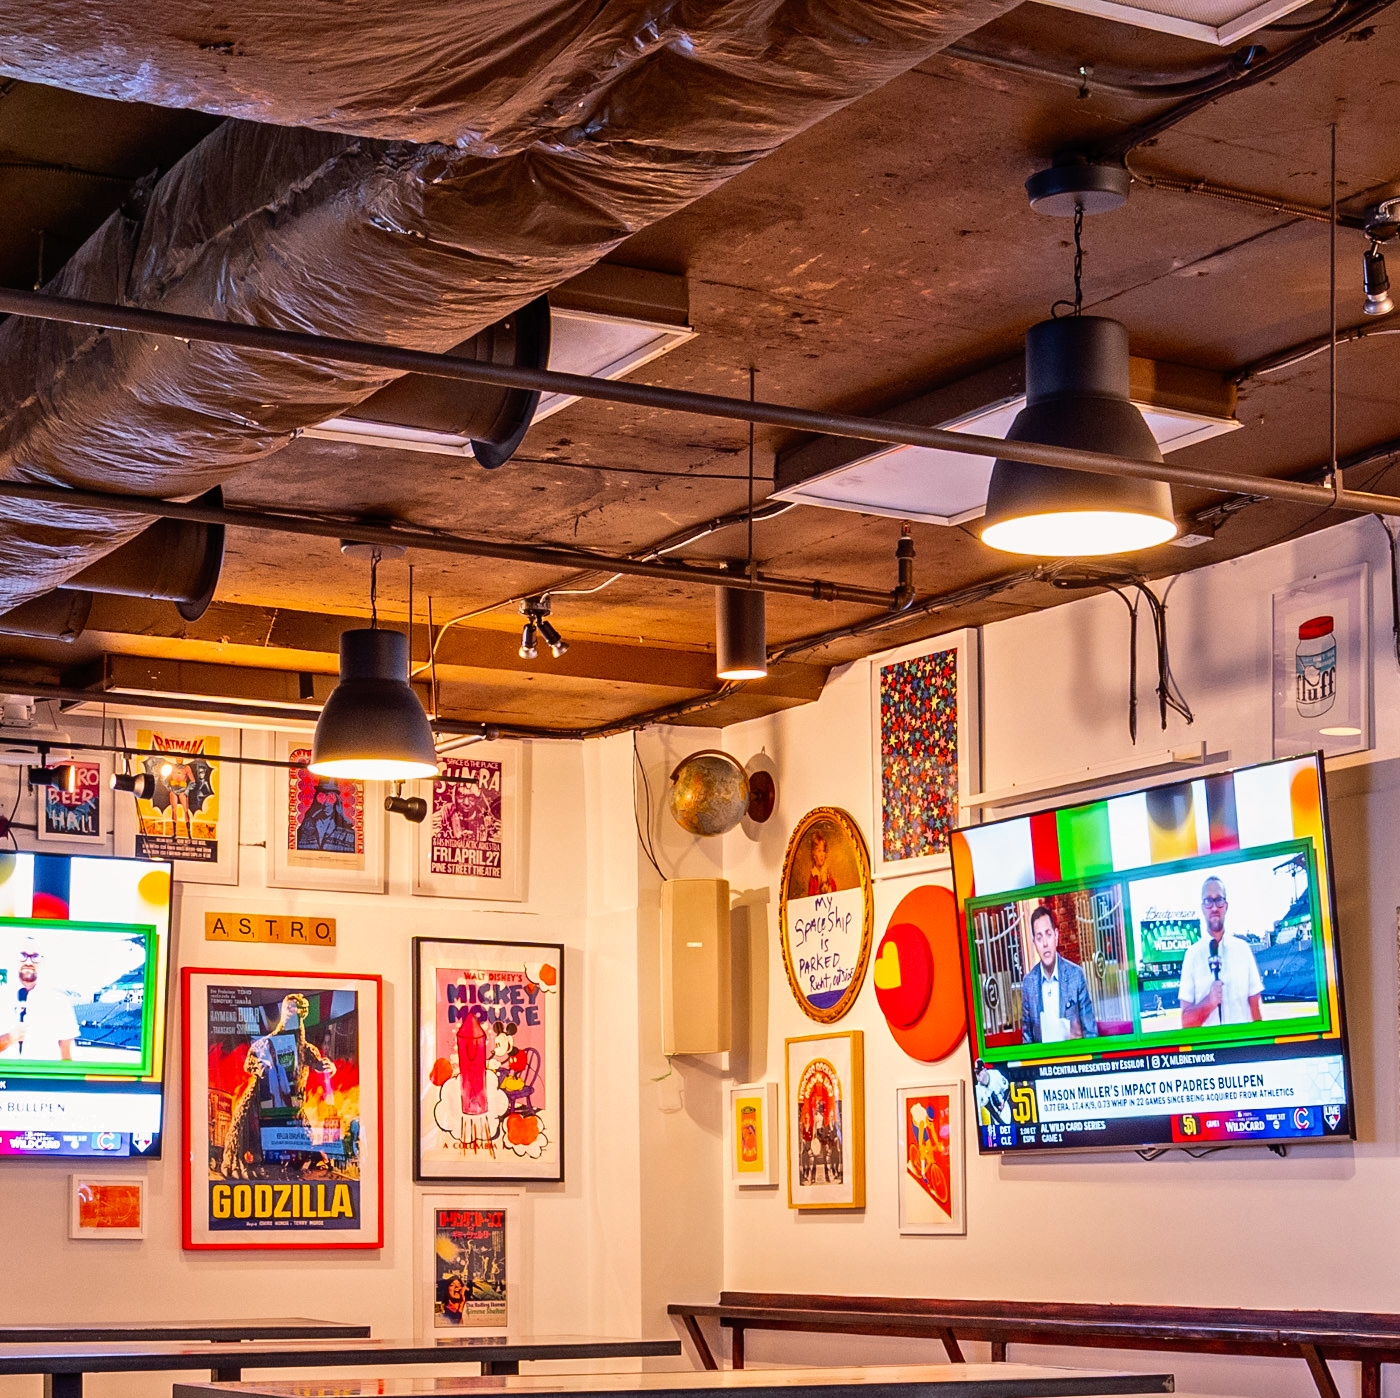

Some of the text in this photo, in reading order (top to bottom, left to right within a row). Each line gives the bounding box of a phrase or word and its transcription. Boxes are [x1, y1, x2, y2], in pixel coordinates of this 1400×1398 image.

[153, 734, 204, 755] BATMAN
[446, 758, 464, 767] SPACE
[470, 760, 480, 768] THE
[480, 761, 499, 769] PLACE
[479, 769, 500, 792] RA
[47, 788, 96, 809] BEER
[52, 809, 97, 834] HALL
[455, 848, 484, 865] APRIL
[485, 852, 500, 866] 27
[431, 863, 500, 877] PINE STREET THEATRE
[799, 952, 841, 978] PARKED
[464, 972, 523, 983] WALT DISNEY'S
[447, 983, 540, 1005] MICKEY
[448, 1005, 541, 1027] MOUSE
[1040, 1067, 1052, 1076] MLB
[1052, 1065, 1078, 1076] CENTRAL
[1078, 1062, 1111, 1074] PRESENTED
[1043, 1074, 1264, 1101] MASON MILLER'S IMPACT ON PADRES BULLPEN
[1111, 1099, 1129, 1107] WHIP
[1167, 1096, 1185, 1104] SINCE
[1185, 1094, 1205, 1103] BEING
[1206, 1092, 1238, 1102] ACQUIRED
[1239, 1091, 1258, 1100] FROM
[1259, 1089, 1295, 1098] ATHLETICS
[1049, 1123, 1066, 1133] WILD
[1066, 1122, 1083, 1132] CARD
[1083, 1120, 1107, 1131] SERIES
[1041, 1135, 1058, 1143] GAME
[212, 1184, 354, 1219] GODZILLA
